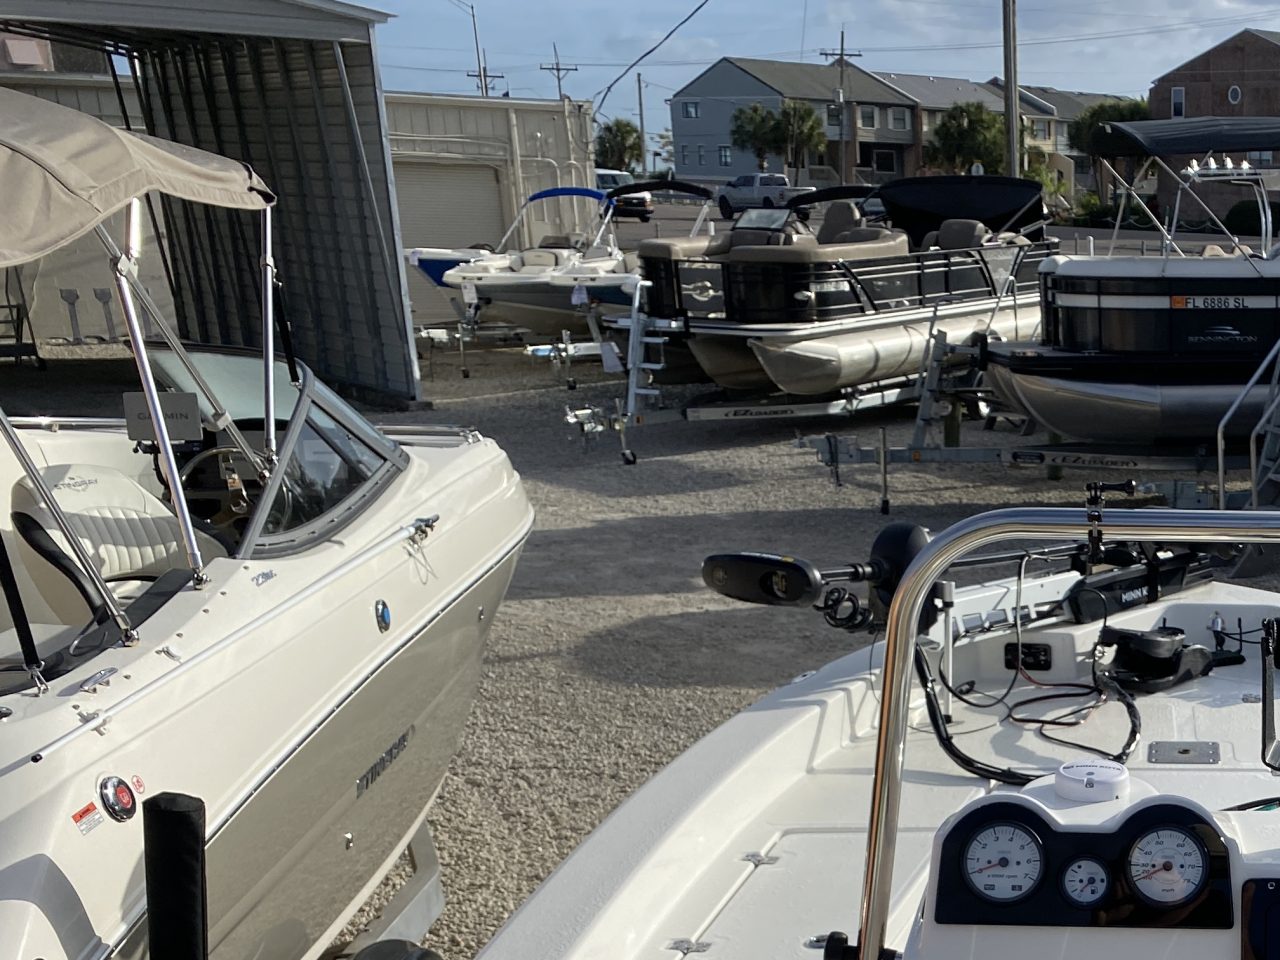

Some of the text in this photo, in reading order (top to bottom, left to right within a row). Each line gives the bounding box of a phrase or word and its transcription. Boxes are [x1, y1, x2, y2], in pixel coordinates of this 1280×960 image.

[1185, 298, 1249, 308] FL 6886 SL
[137, 412, 189, 421] GAMIN
